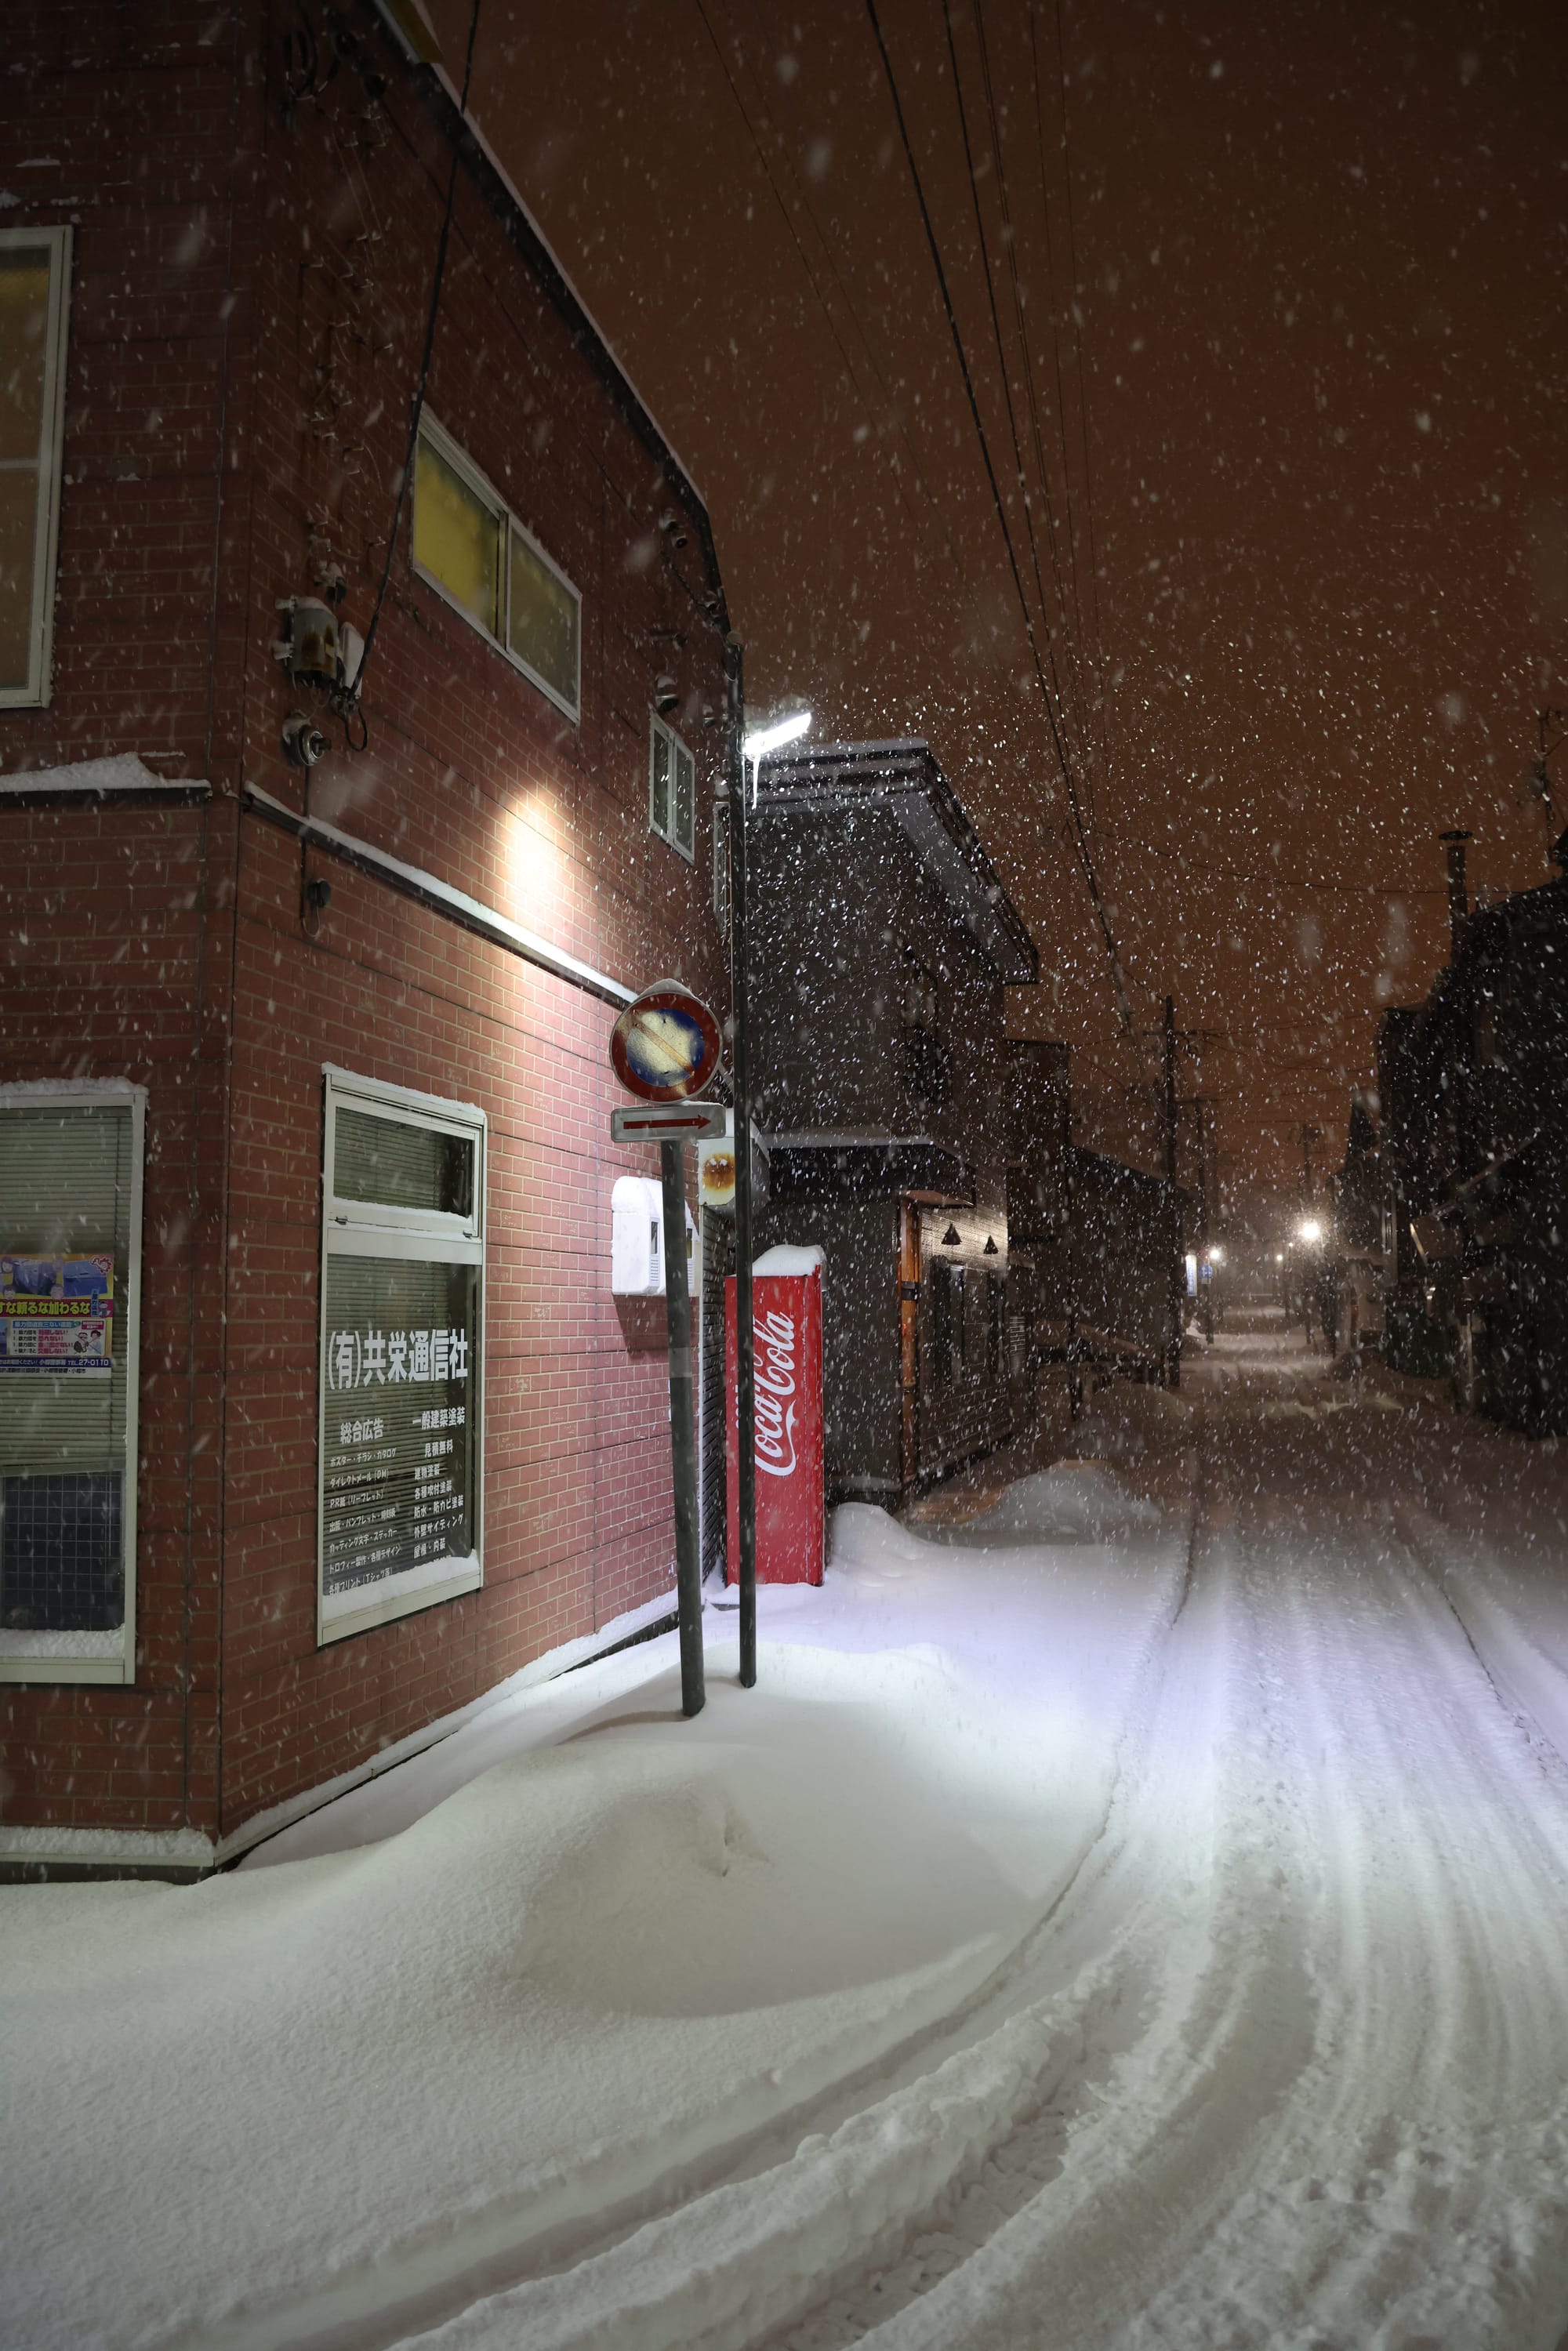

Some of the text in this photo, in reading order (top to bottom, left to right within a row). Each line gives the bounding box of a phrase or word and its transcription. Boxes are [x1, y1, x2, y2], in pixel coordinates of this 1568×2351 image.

[328, 1328, 469, 1390] (有)共栄通信社
[753, 1310, 797, 1476] Coca-Cola
[339, 1417, 384, 1445] 総合広告
[412, 1406, 466, 1431] 一般建築塗装
[424, 1439, 454, 1458] 見積無料
[414, 1463, 440, 1481] 建物塗装
[414, 1479, 452, 1500] 各種吹付塗装
[414, 1494, 464, 1519] 防水・防カビ塗装
[413, 1536, 446, 1559] 屋根・内装
